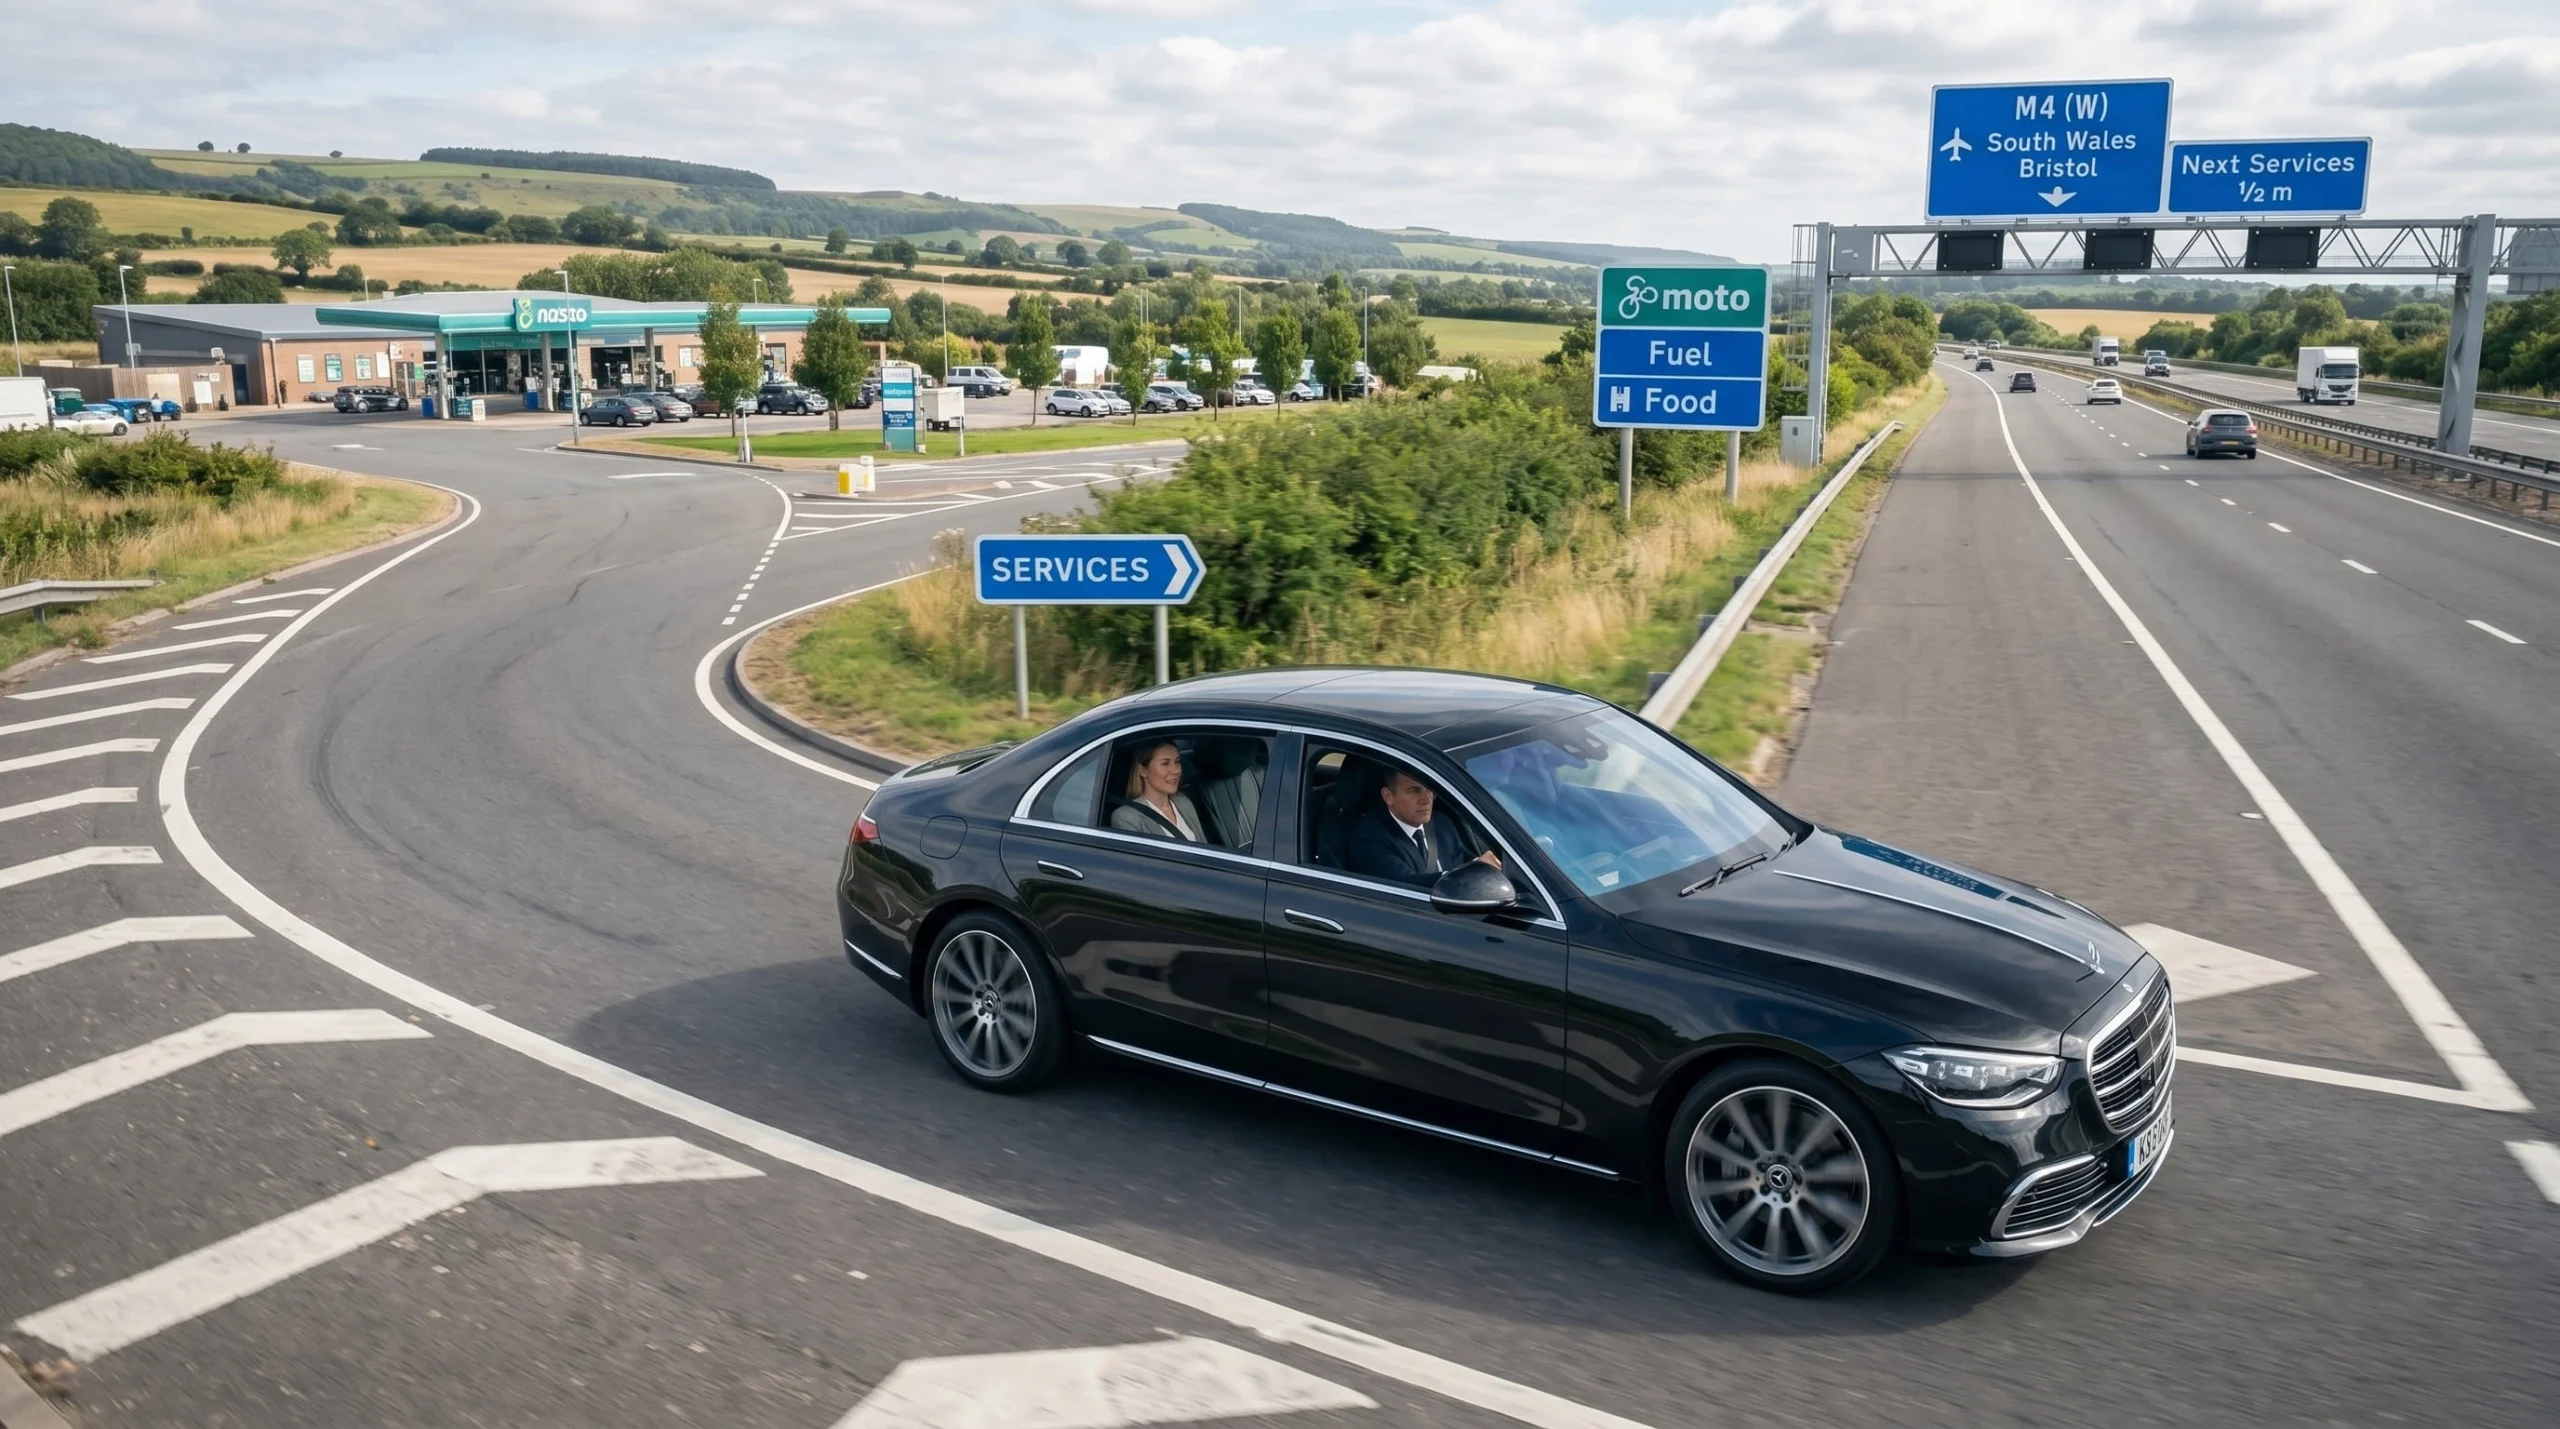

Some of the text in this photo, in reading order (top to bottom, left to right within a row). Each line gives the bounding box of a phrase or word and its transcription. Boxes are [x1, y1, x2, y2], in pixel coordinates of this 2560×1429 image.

[2015, 92, 2108, 122] M4 (W)
[1987, 131, 2137, 152] South Wales
[2019, 158, 2098, 178] Bristol
[2182, 152, 2355, 174] Next Services
[2272, 186, 2292, 201] m
[1662, 284, 1750, 311] moto
[1650, 340, 1712, 366] Fuel
[1645, 387, 1717, 414] Food
[992, 557, 1150, 582] SERVICES
